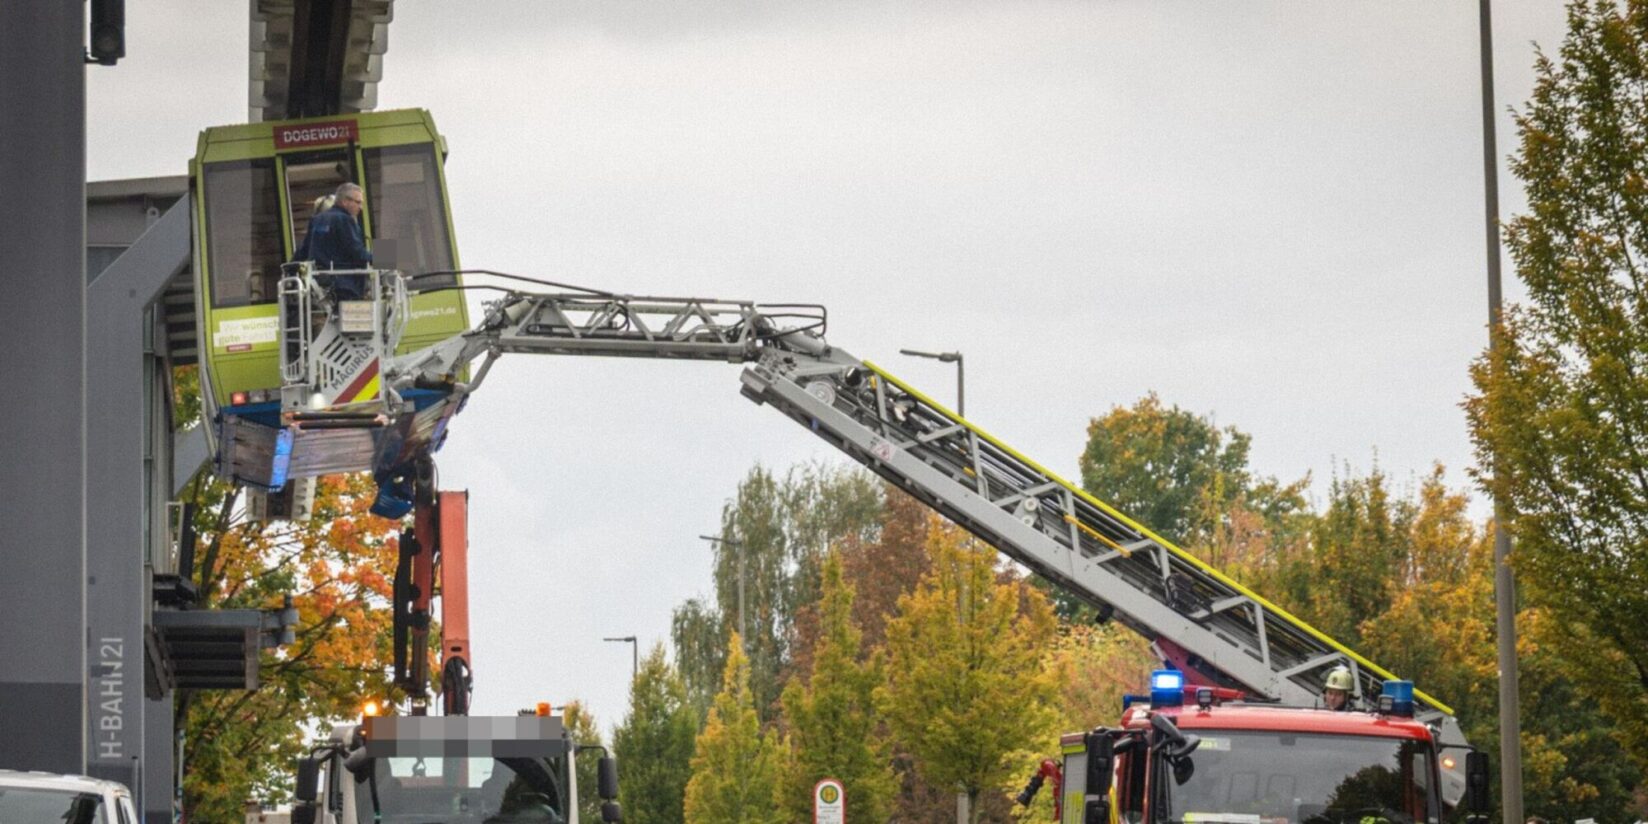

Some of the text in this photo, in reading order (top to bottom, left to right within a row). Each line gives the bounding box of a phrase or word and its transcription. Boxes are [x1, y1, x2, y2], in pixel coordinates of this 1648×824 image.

[283, 126, 350, 143] DOGEWO21
[331, 345, 375, 390] MAGIRUS
[100, 638, 123, 758] H-BAHN21
